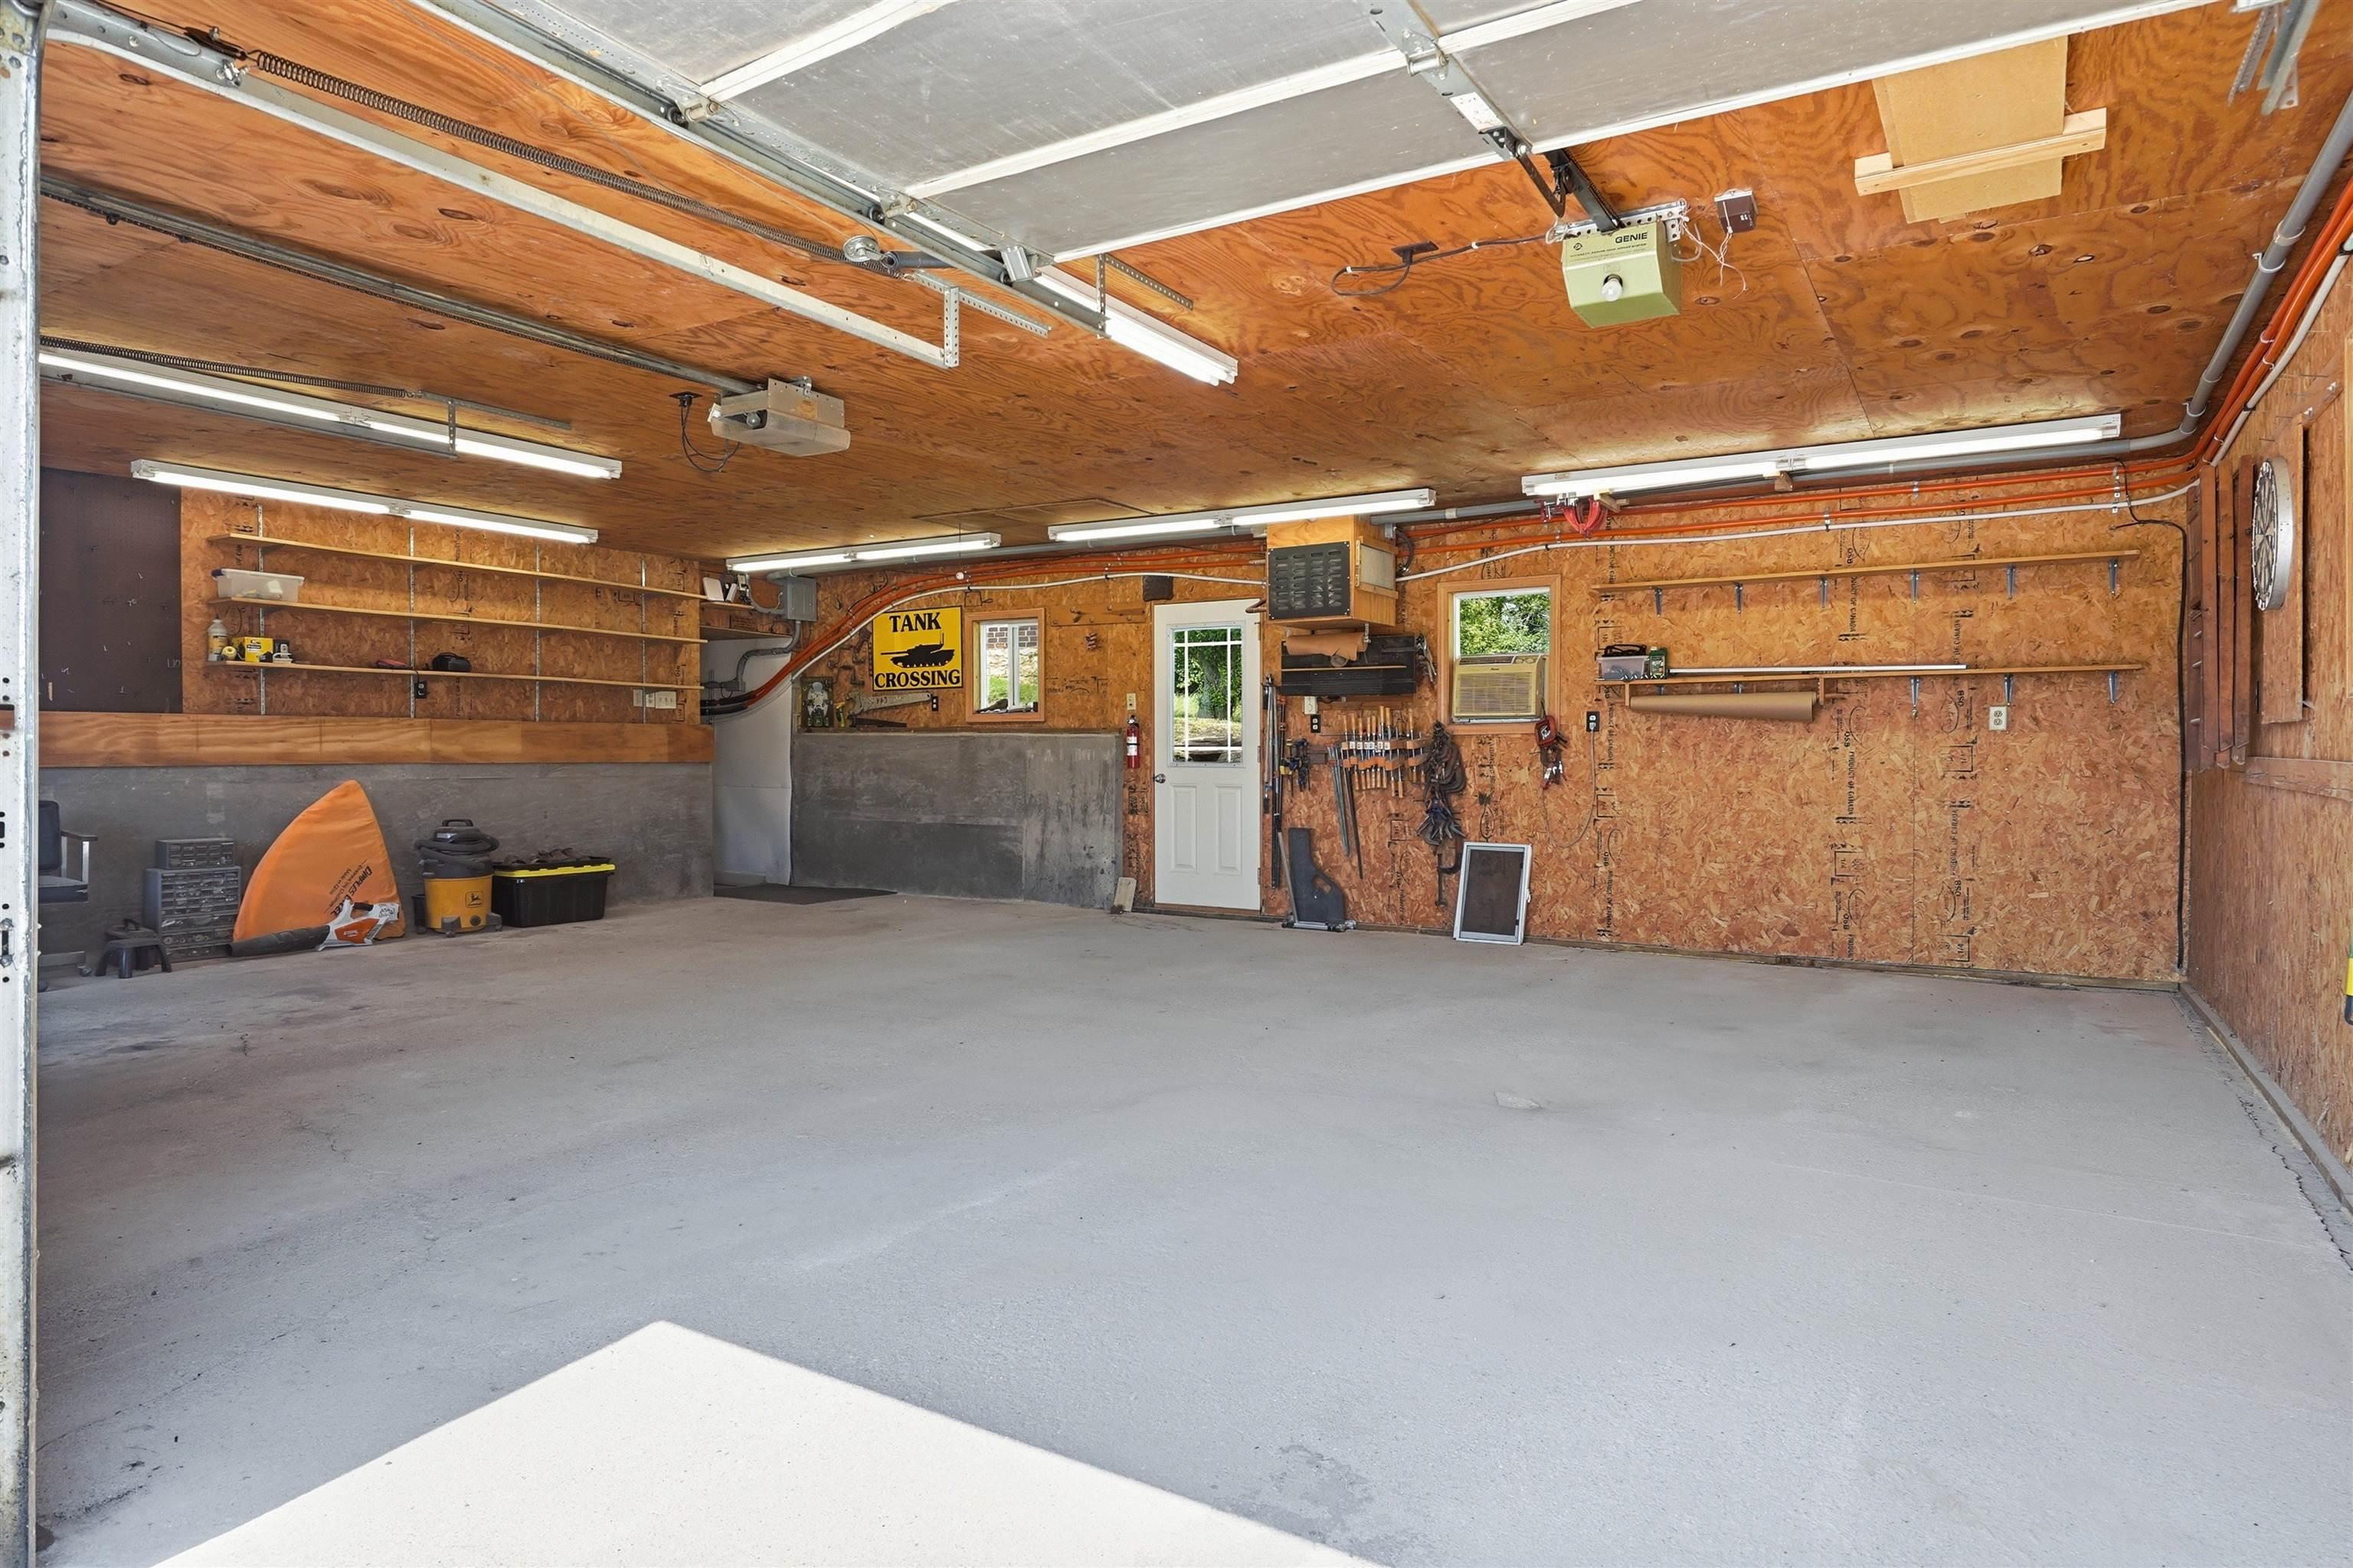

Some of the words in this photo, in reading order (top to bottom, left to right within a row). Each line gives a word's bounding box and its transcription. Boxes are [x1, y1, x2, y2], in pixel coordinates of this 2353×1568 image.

[1615, 231, 1648, 244] GENIE
[889, 611, 942, 633] TANK
[874, 669, 961, 689] CROSSING
[1847, 751, 1856, 779] PRODUCT
[1847, 781, 1854, 789] OF
[1950, 809, 1959, 834] CANADA
[348, 866, 373, 895] DIMPLES
